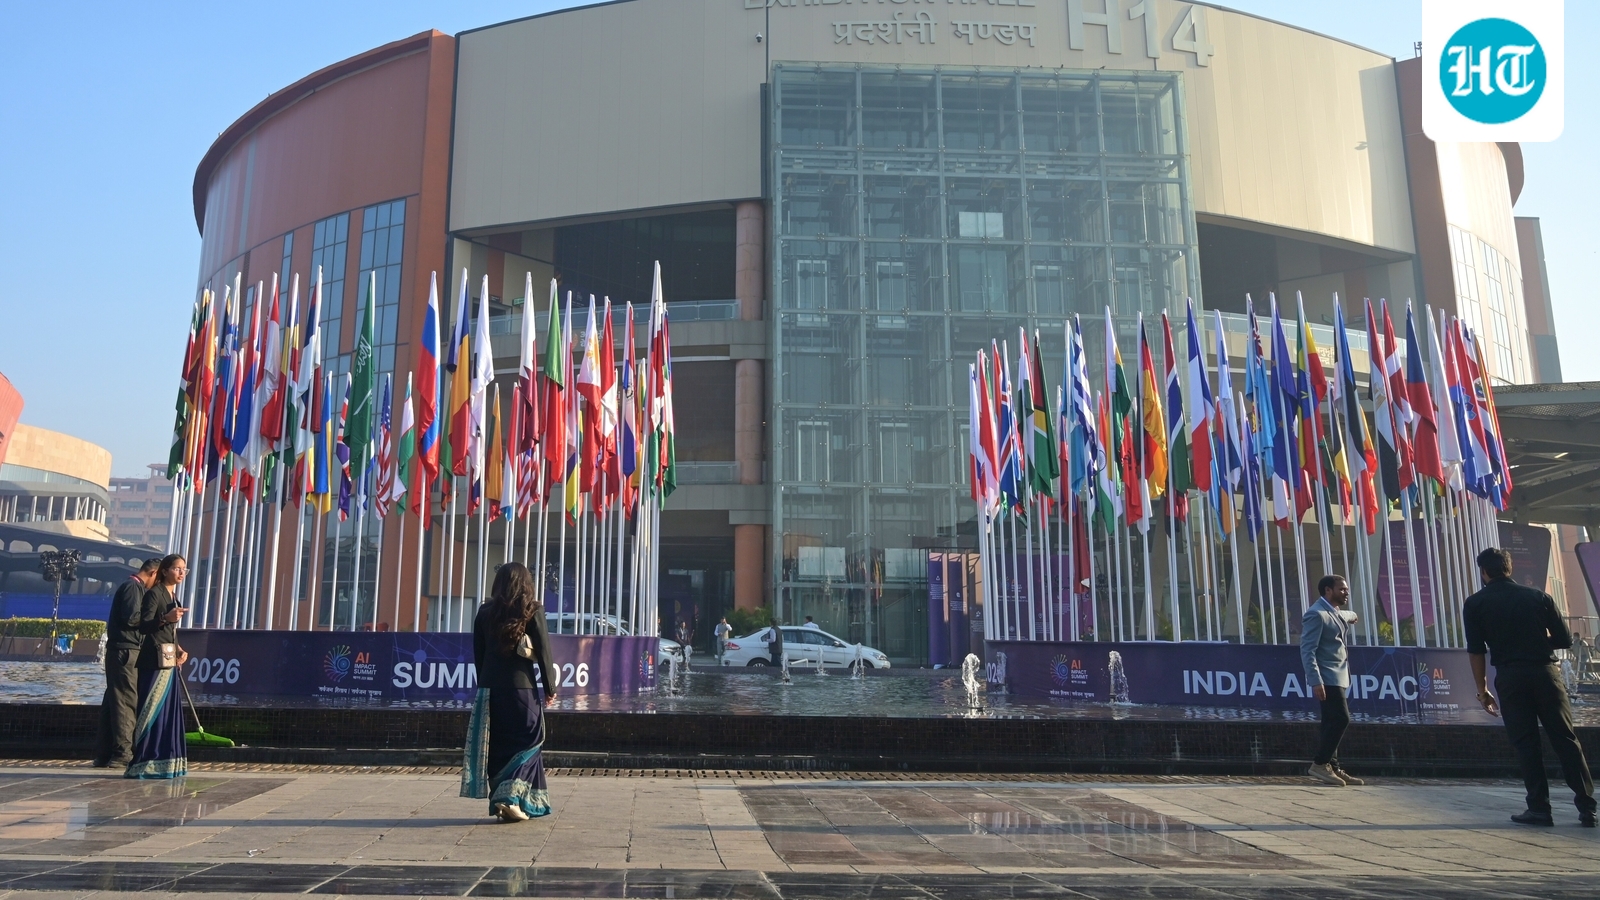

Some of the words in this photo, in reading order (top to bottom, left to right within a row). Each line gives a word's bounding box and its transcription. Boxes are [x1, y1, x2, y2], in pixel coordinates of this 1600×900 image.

[832, 10, 938, 45] प्रदर्शनी
[950, 20, 1037, 48] मण्डप
[1067, 0, 1215, 68] H14
[188, 657, 241, 684] 2026
[355, 652, 370, 664] AI
[1071, 660, 1081, 670] AI
[1183, 670, 1273, 697] INDIA
[1433, 668, 1443, 679] AI
